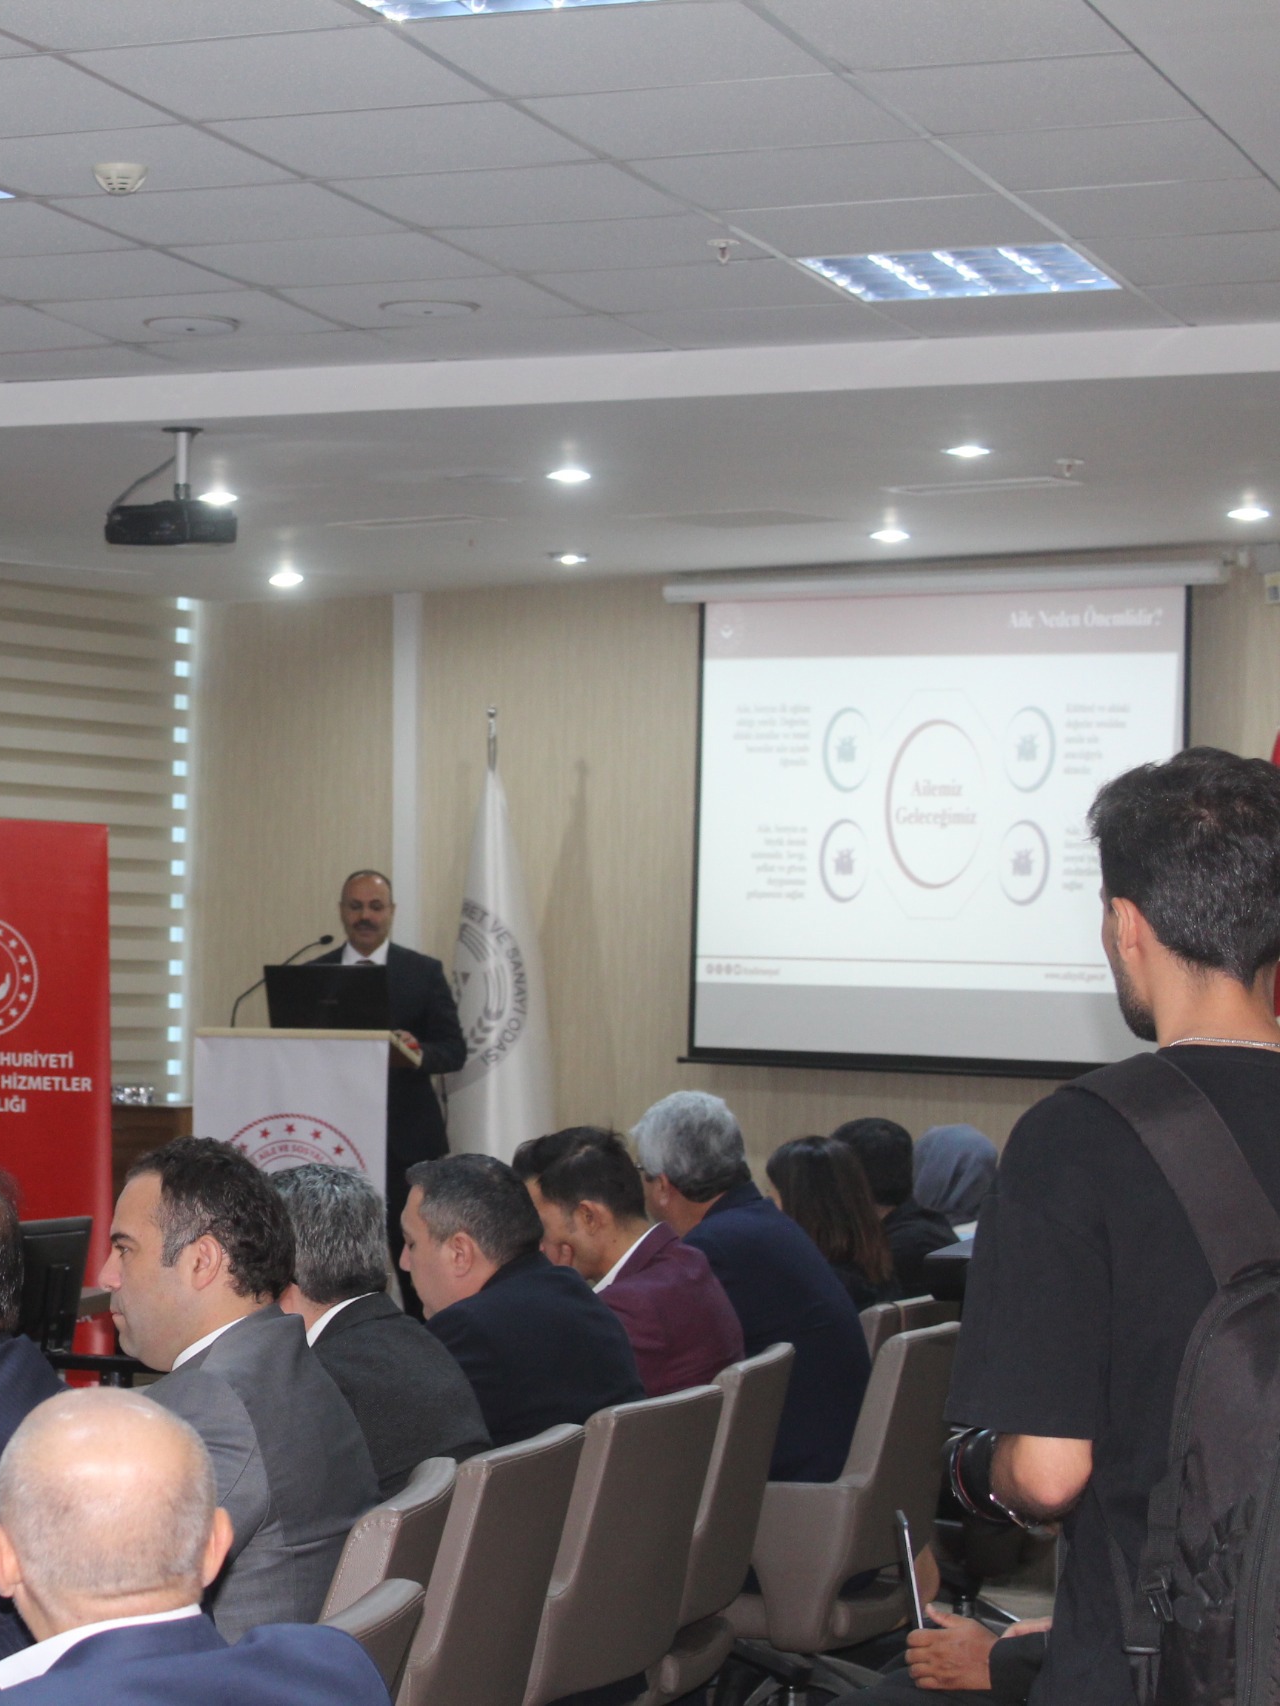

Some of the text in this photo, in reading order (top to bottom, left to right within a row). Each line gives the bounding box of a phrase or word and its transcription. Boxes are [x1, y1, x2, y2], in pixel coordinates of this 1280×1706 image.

[910, 779, 963, 797] Ailemiz
[895, 806, 977, 829] Geleceğimiz
[1, 1074, 93, 1092] HİZMETLER
